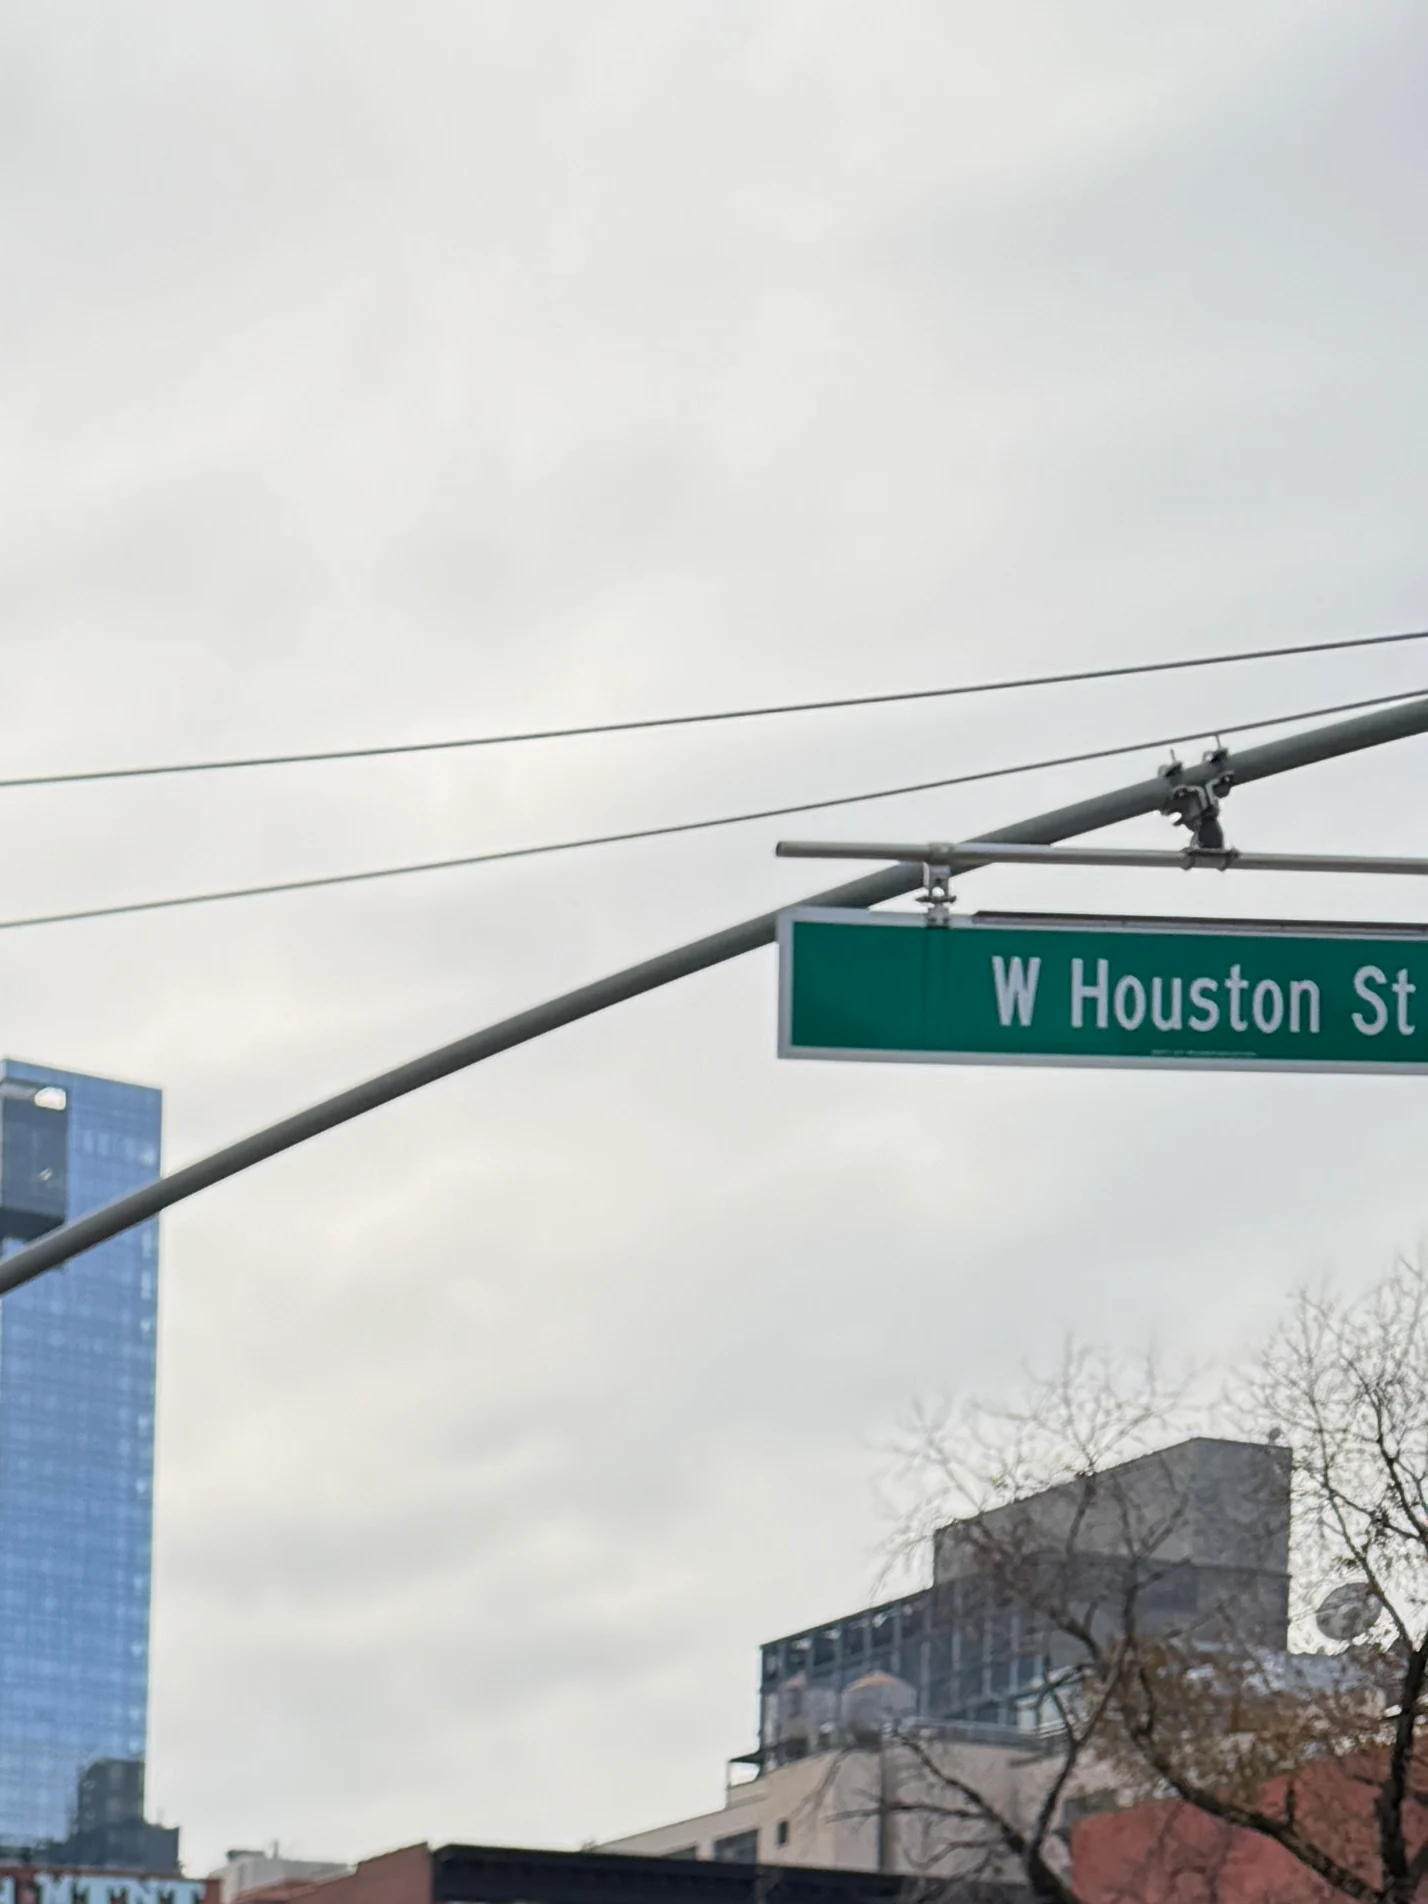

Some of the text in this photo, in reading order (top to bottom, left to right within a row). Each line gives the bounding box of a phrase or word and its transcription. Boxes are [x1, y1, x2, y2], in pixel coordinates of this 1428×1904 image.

[992, 955, 1417, 1037] W Houston St
